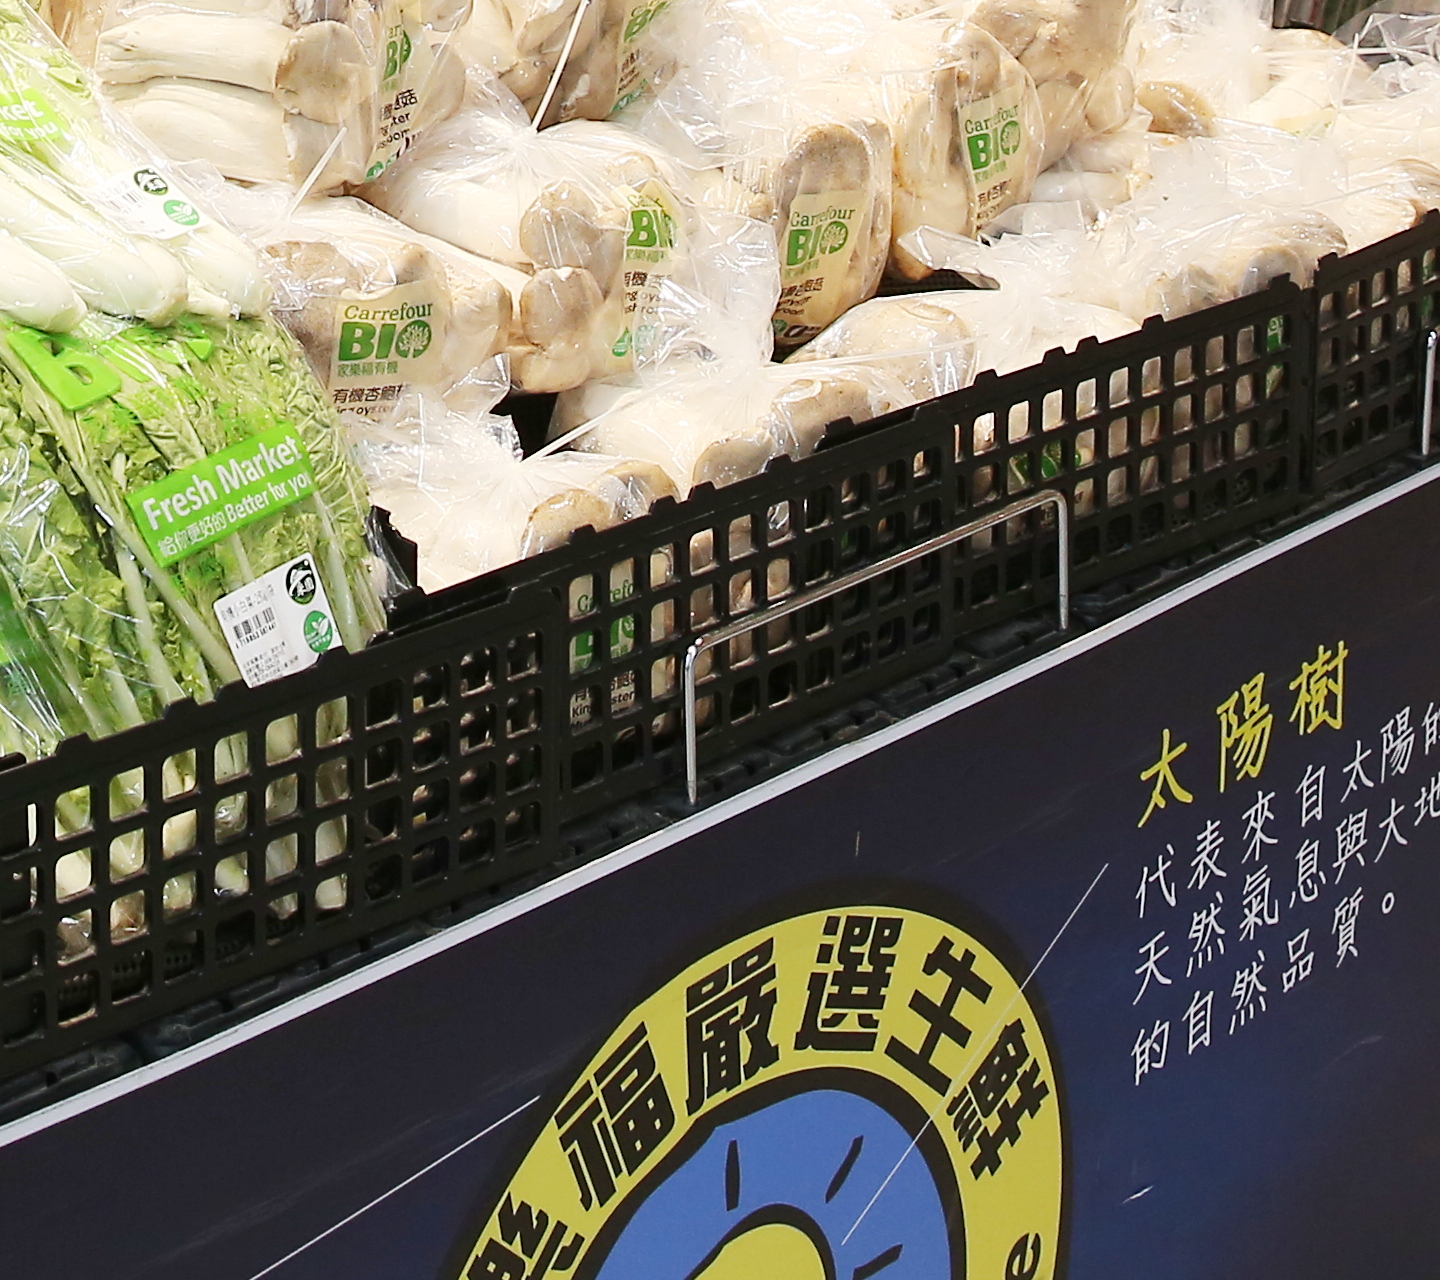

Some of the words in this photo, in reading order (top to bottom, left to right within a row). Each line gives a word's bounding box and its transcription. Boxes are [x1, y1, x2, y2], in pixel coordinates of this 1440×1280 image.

[966, 120, 1022, 171] BIO
[785, 220, 850, 267] BIO
[343, 299, 435, 322] Carrefour
[336, 319, 433, 363] BIO
[140, 474, 219, 532] Fresh
[218, 433, 305, 493] Market
[156, 511, 228, 559] 給你更好的
[225, 489, 270, 522] Better
[268, 480, 291, 503] for
[1138, 641, 1349, 828] 太陽樹
